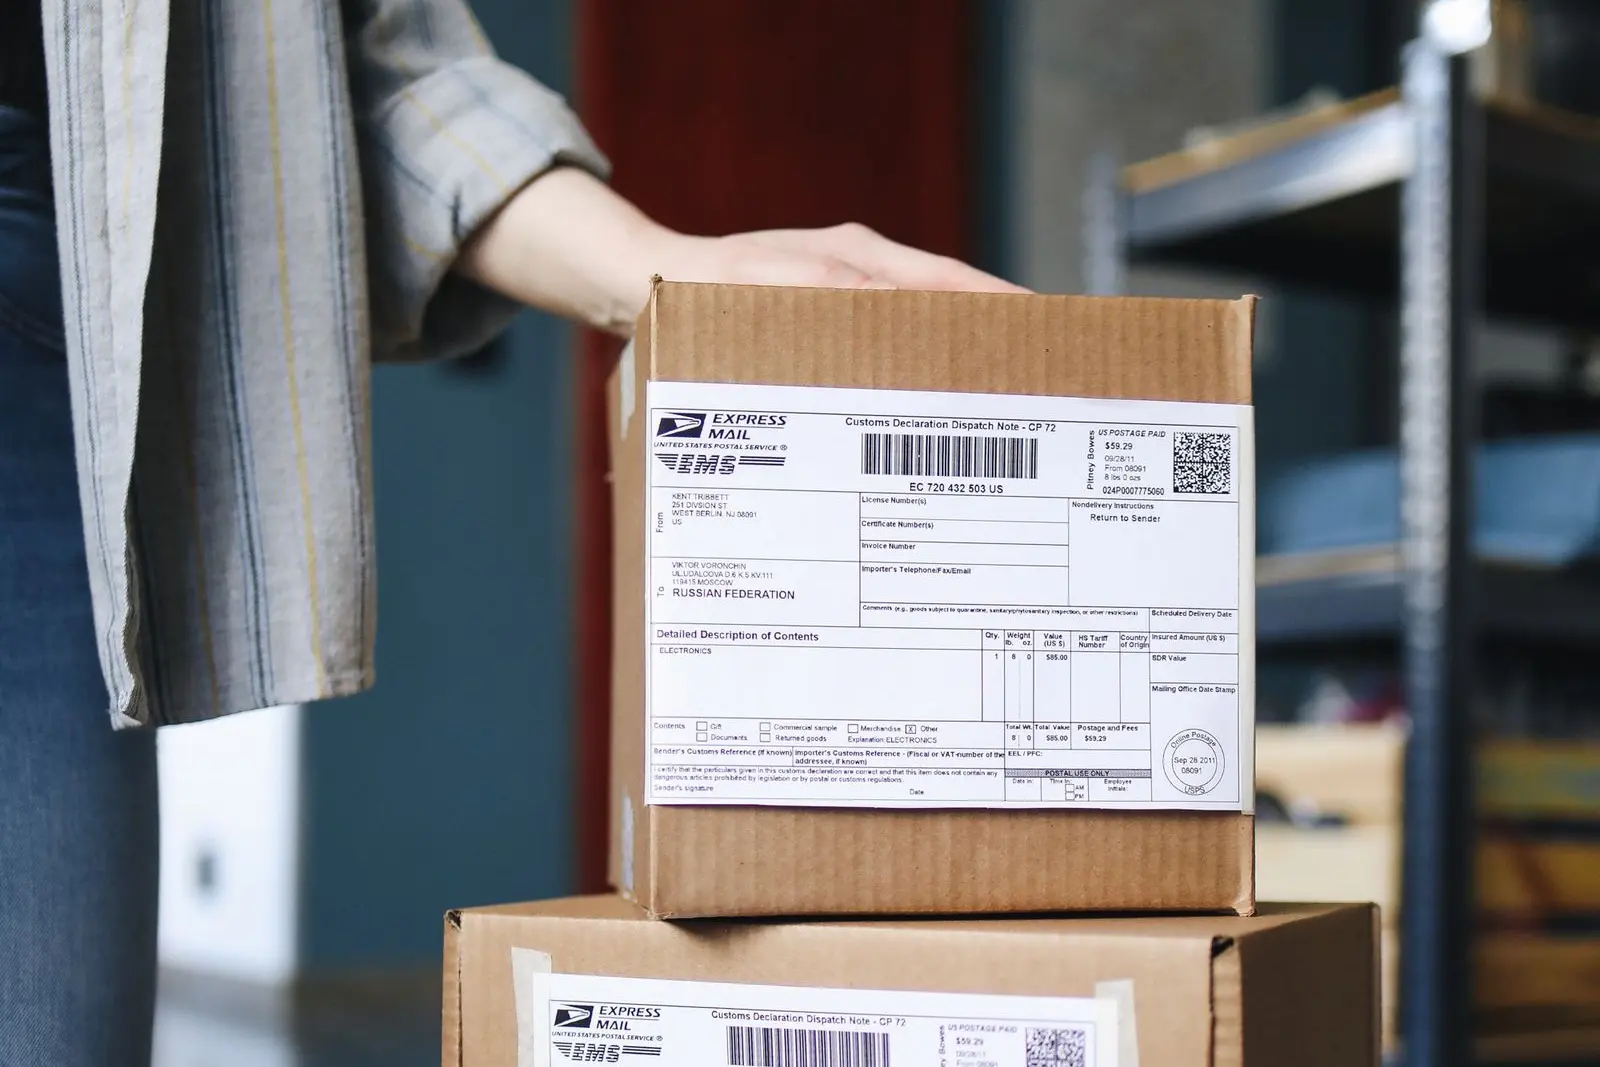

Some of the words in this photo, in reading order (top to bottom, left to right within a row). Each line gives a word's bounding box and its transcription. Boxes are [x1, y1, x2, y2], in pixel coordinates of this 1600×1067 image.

[712, 413, 787, 426] EXPRESS
[845, 418, 890, 427] Customs
[893, 419, 949, 429] Declaration
[952, 420, 994, 430] Dispatch
[997, 422, 1020, 431] Note
[1028, 423, 1043, 432] CP
[1045, 423, 1056, 432] 72
[708, 429, 751, 440] MAIL
[1108, 429, 1146, 437] POSTAGE
[1087, 430, 1095, 460] Bowes
[1104, 442, 1133, 450] $59.29
[676, 454, 736, 475] EMS
[1087, 462, 1095, 490] Pitney
[909, 483, 924, 492] EC
[927, 483, 945, 492] 720
[947, 484, 966, 493] 432
[968, 484, 986, 493] 503
[989, 484, 1004, 494] US
[1102, 487, 1165, 496] 024P0007775060
[862, 496, 890, 504] License
[890, 497, 927, 505] Number(s)
[1114, 502, 1154, 510] Instructions
[1090, 514, 1118, 522] Return
[898, 521, 934, 529] Number(s)
[862, 566, 898, 574] Importer's
[899, 566, 972, 575] Telephone/Fax/Email
[657, 586, 664, 597] To
[672, 588, 722, 598] RUSSIAN
[724, 589, 796, 599] FEDERATION
[1188, 610, 1216, 618] Delivery
[656, 630, 698, 639] Detailed
[700, 630, 758, 640] Description
[760, 631, 772, 640] of
[774, 632, 820, 641] Contents
[984, 632, 1000, 640] Qty.
[1006, 632, 1031, 640] Weight
[1078, 634, 1089, 642] HS
[1120, 634, 1148, 643] Country
[1043, 640, 1057, 648] (US
[1058, 640, 1065, 648] $)
[1152, 685, 1177, 693] Mailing
[1214, 686, 1236, 694] Stamp
[1170, 732, 1190, 749] Online
[1191, 732, 1217, 747] Postage
[1173, 757, 1188, 765] Sep
[1184, 786, 1205, 794] USPS
[599, 1006, 661, 1018] EXPRESS
[711, 1011, 751, 1021] Customs
[753, 1012, 804, 1023] Declaration
[806, 1014, 847, 1024] Dispatch
[849, 1016, 870, 1025] Note
[879, 1017, 893, 1026] CP
[895, 1018, 906, 1026] 72
[596, 1020, 631, 1031] MAIL
[570, 1044, 620, 1063] EMS
